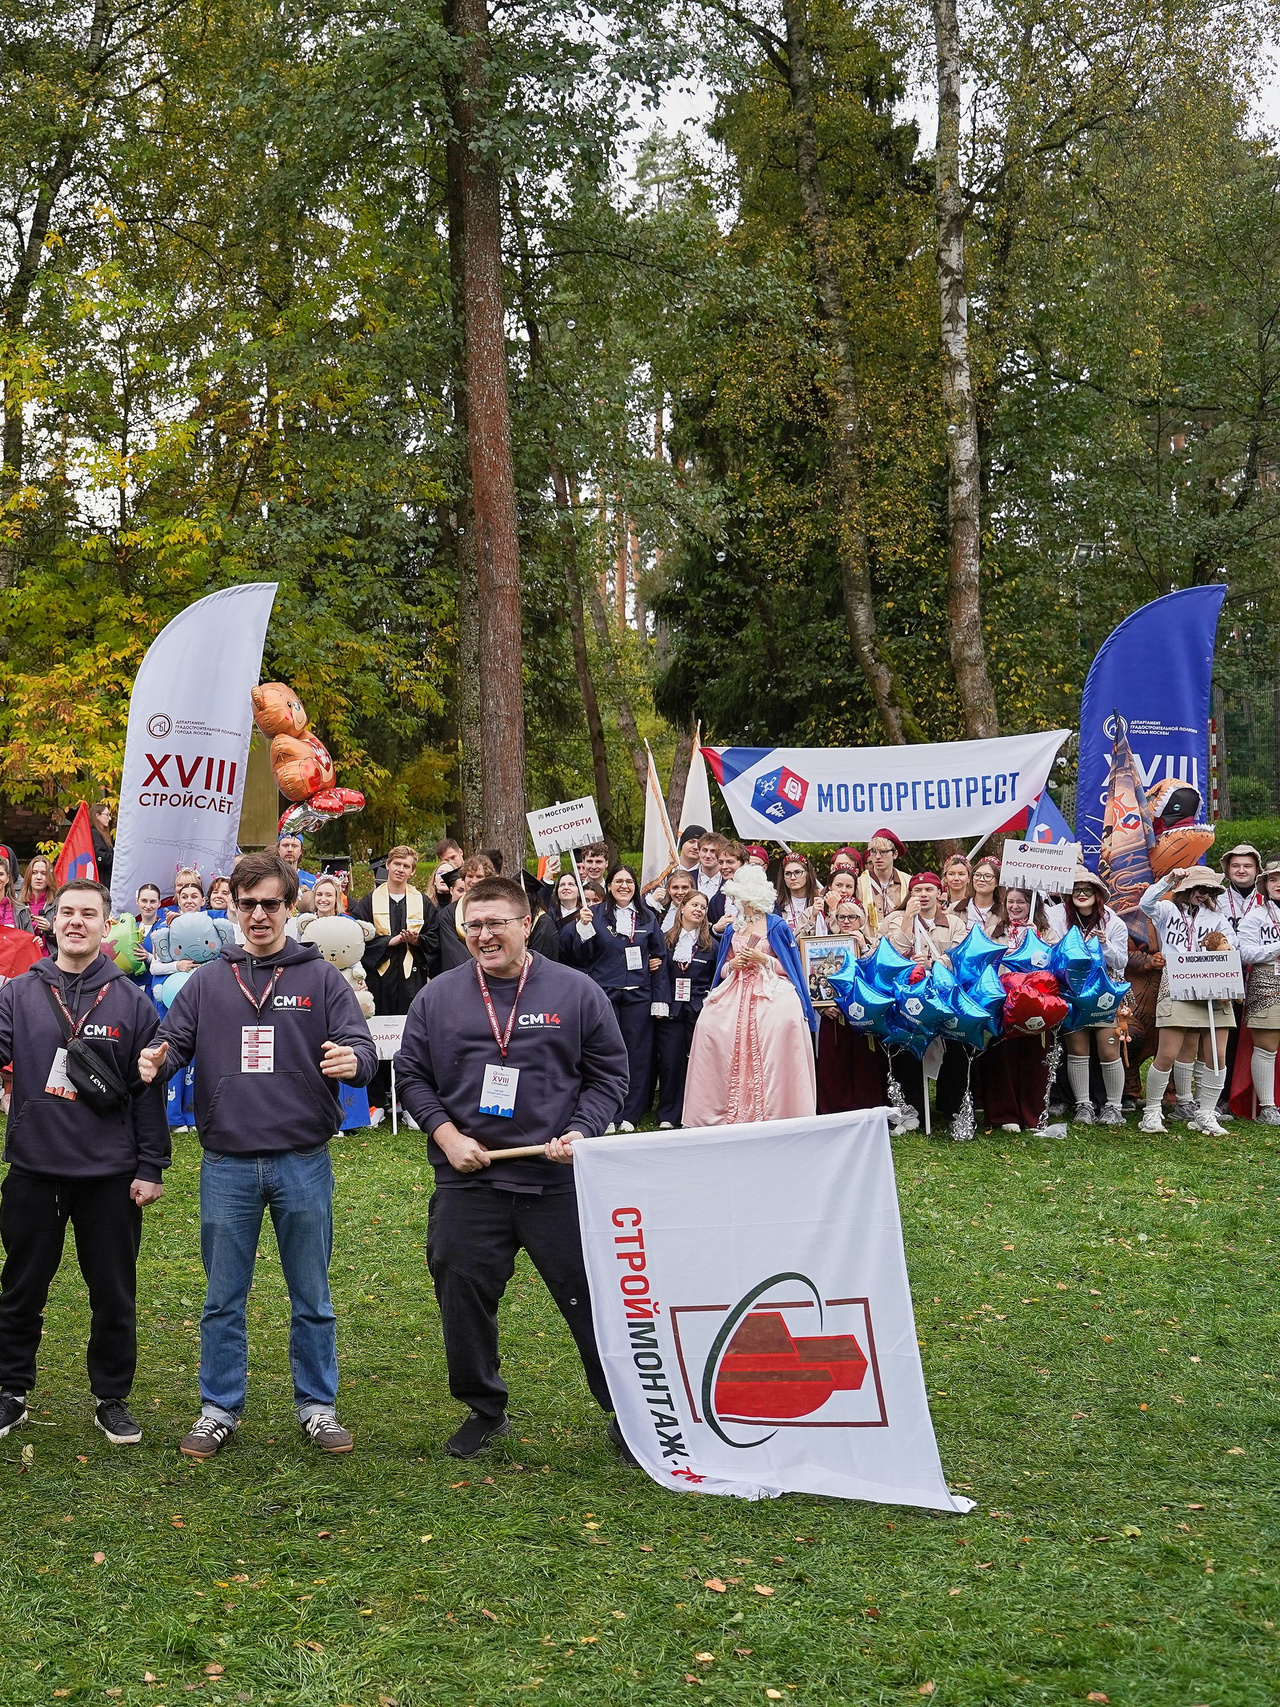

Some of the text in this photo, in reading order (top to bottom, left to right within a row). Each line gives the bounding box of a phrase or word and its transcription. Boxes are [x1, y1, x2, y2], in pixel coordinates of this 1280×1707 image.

[141, 753, 237, 796] XVIII
[817, 772, 1020, 813] МОСГОРГЕОТРЕСТ
[138, 790, 234, 815] СТРОЙСЛЁТ
[544, 803, 584, 819] МОСГОРБТИ
[538, 817, 592, 837] МОСГОРБТИ
[1029, 846, 1064, 856] МОСГОРГЕОТРЕСТ
[1005, 860, 1072, 873] МОСГОРГЕОТРЕСТ
[1185, 954, 1228, 963] МОСИНЖПРОЕКТ
[1172, 972, 1240, 980] МОСИНЖПРОЕКТ
